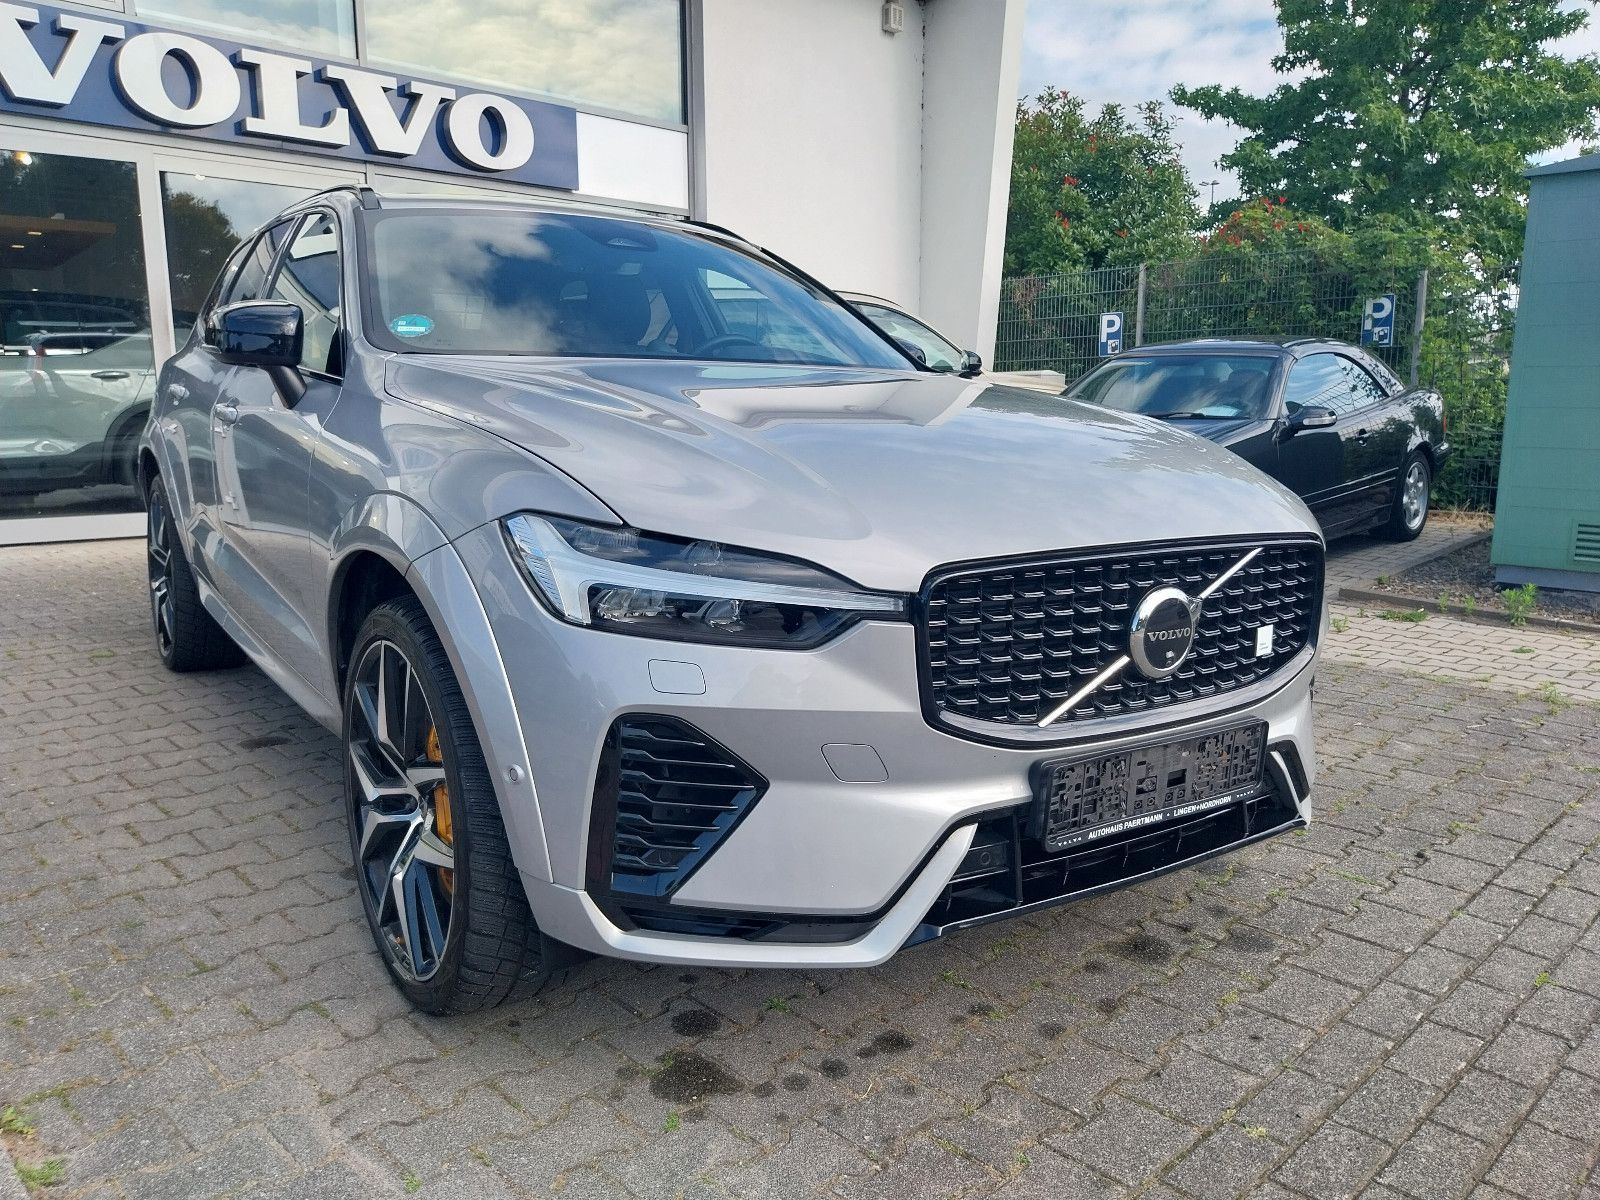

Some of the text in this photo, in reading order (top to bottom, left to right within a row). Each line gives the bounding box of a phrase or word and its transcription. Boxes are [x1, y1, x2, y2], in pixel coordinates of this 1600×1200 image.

[0, 4, 535, 171] VOLVO
[1365, 297, 1392, 330] P
[1101, 314, 1121, 343] P
[1147, 627, 1191, 642] VOLVO
[1087, 823, 1123, 840] AUTOHAUS
[1123, 813, 1164, 830] PAERTMANN
